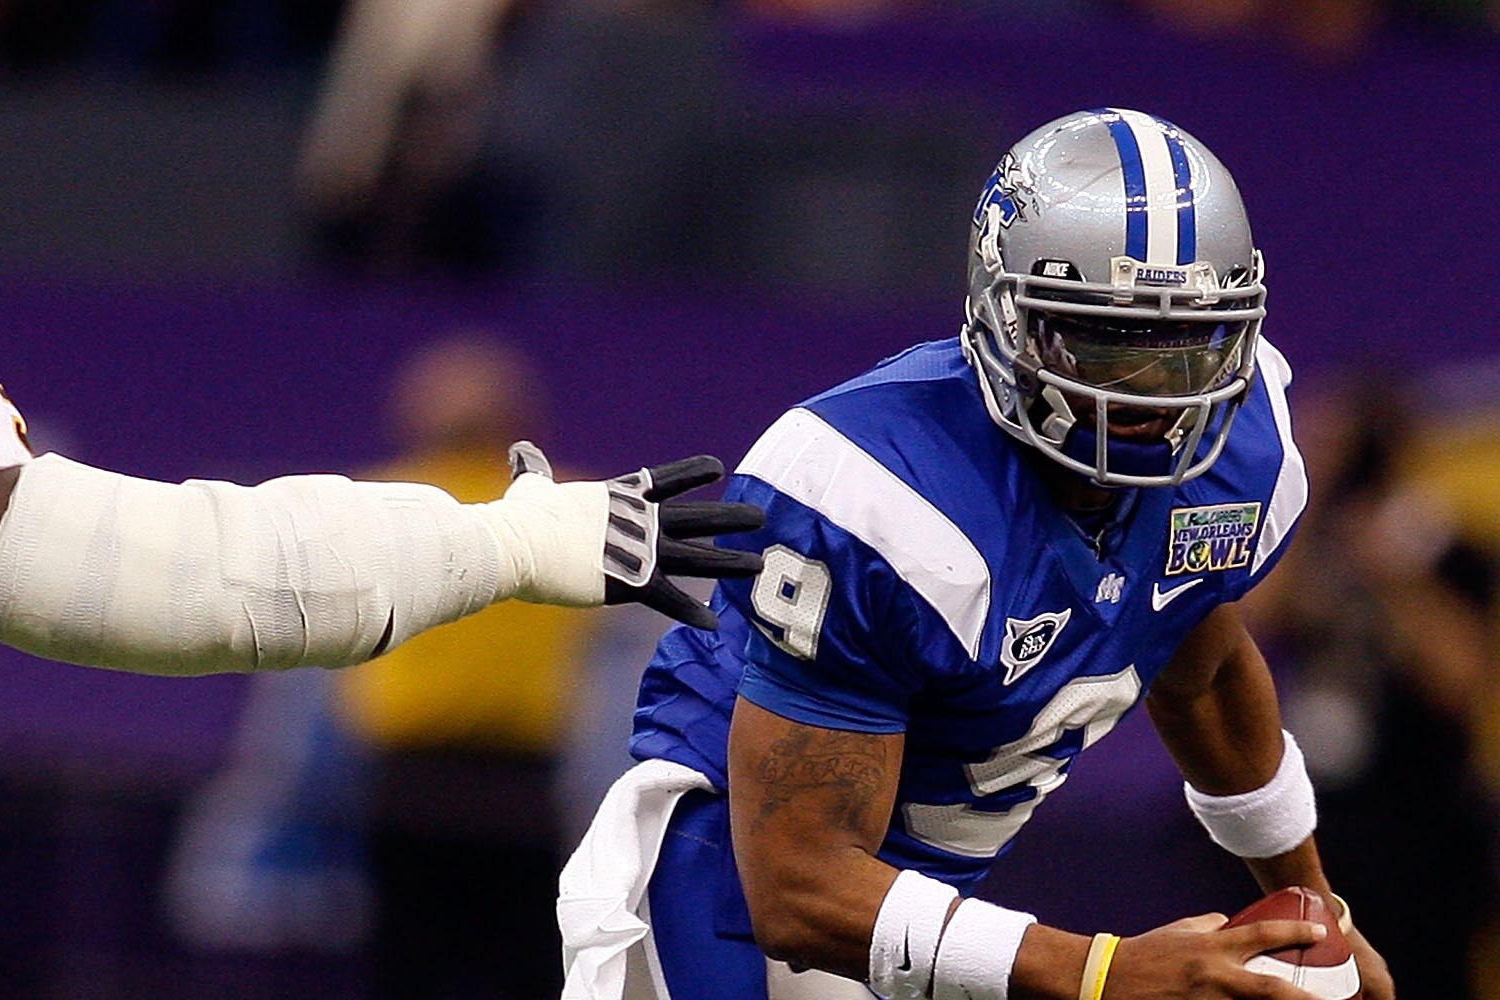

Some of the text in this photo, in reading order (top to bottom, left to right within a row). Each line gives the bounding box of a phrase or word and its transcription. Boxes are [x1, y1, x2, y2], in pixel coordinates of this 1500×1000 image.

[1136, 268, 1187, 284] RAIDERS
[1173, 522, 1254, 543] NEW ORLEANS
[1168, 537, 1248, 572] BOWL
[750, 543, 832, 661] 9
